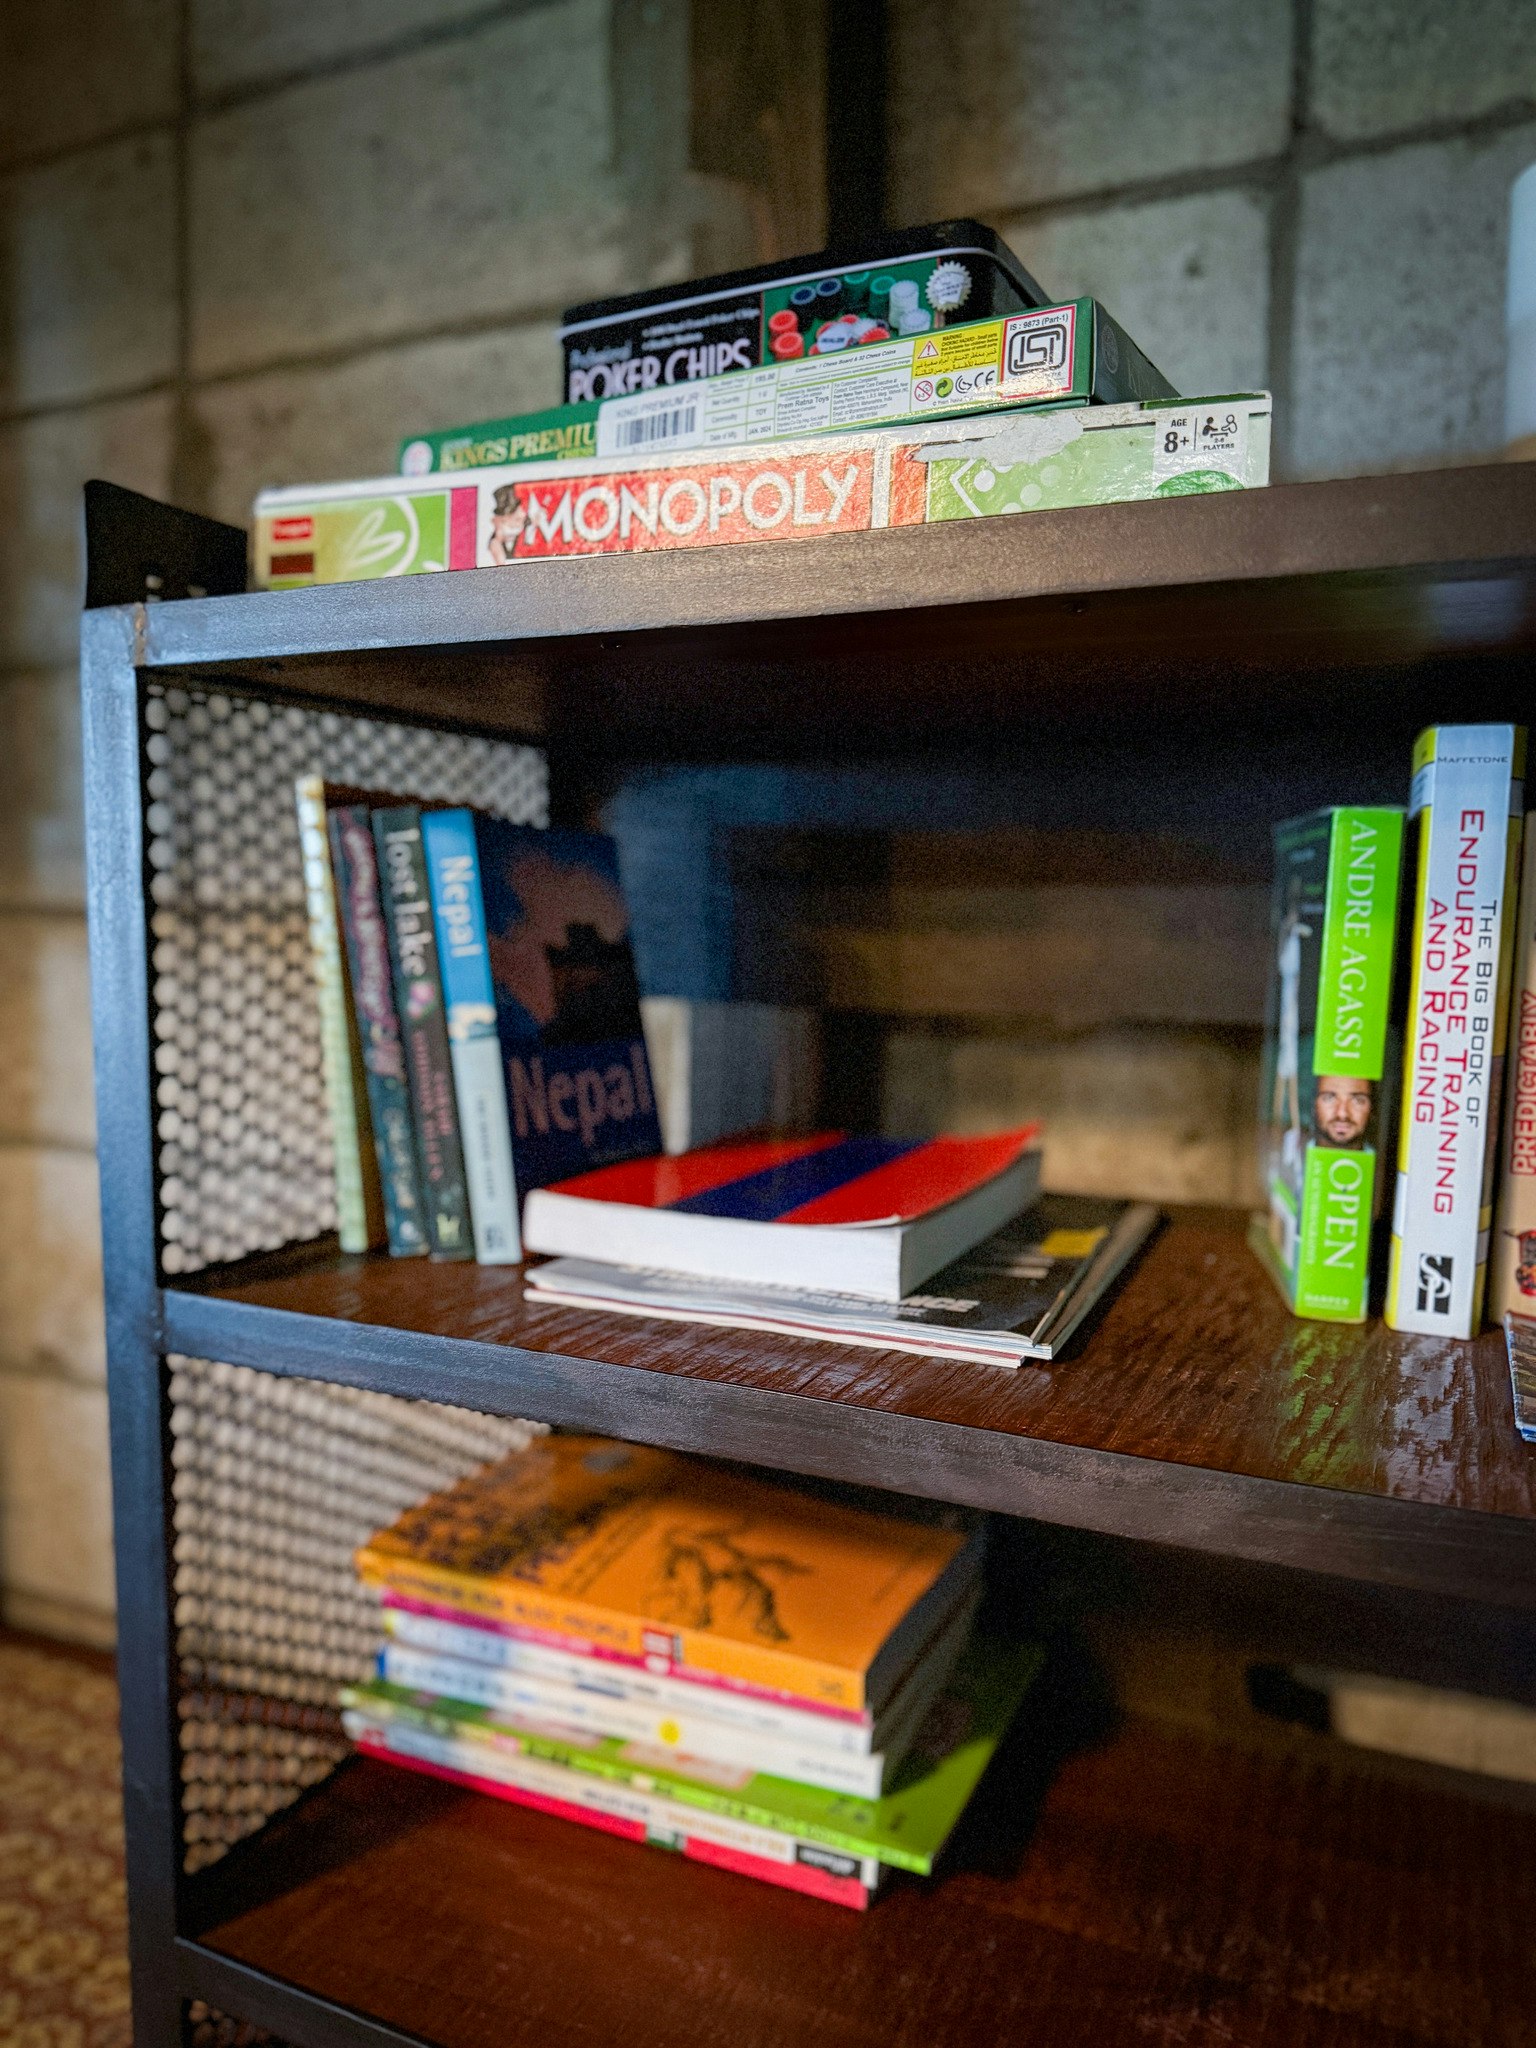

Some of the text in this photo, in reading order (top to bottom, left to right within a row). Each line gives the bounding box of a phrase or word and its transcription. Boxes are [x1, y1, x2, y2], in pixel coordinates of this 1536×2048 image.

[865, 352, 881, 360] Chess
[882, 349, 896, 357] Coins
[1009, 323, 1018, 331] IS
[1023, 320, 1040, 328] 9873
[1042, 313, 1069, 325] (Part-1)
[567, 355, 661, 404] POKER
[664, 337, 751, 385] CHIPS
[777, 401, 794, 409] Prem
[795, 398, 814, 406] Ratna
[815, 395, 830, 403] Toys
[440, 438, 508, 472] KINGS
[510, 422, 597, 459] PREMIU
[1164, 431, 1190, 453] 8+
[1170, 418, 1188, 428] AGE
[524, 464, 861, 546] MONOPOLY
[437, 855, 485, 958] Nepal
[1333, 820, 1378, 1059] ANDRE AGASSI
[1415, 898, 1449, 1123] AND RACING
[1433, 809, 1486, 1214] ENDURANCE TRAINING
[1465, 900, 1498, 1128] THE BIG BOOK OF
[508, 1041, 652, 1149] Nepal
[1323, 1158, 1363, 1269] OPEN
